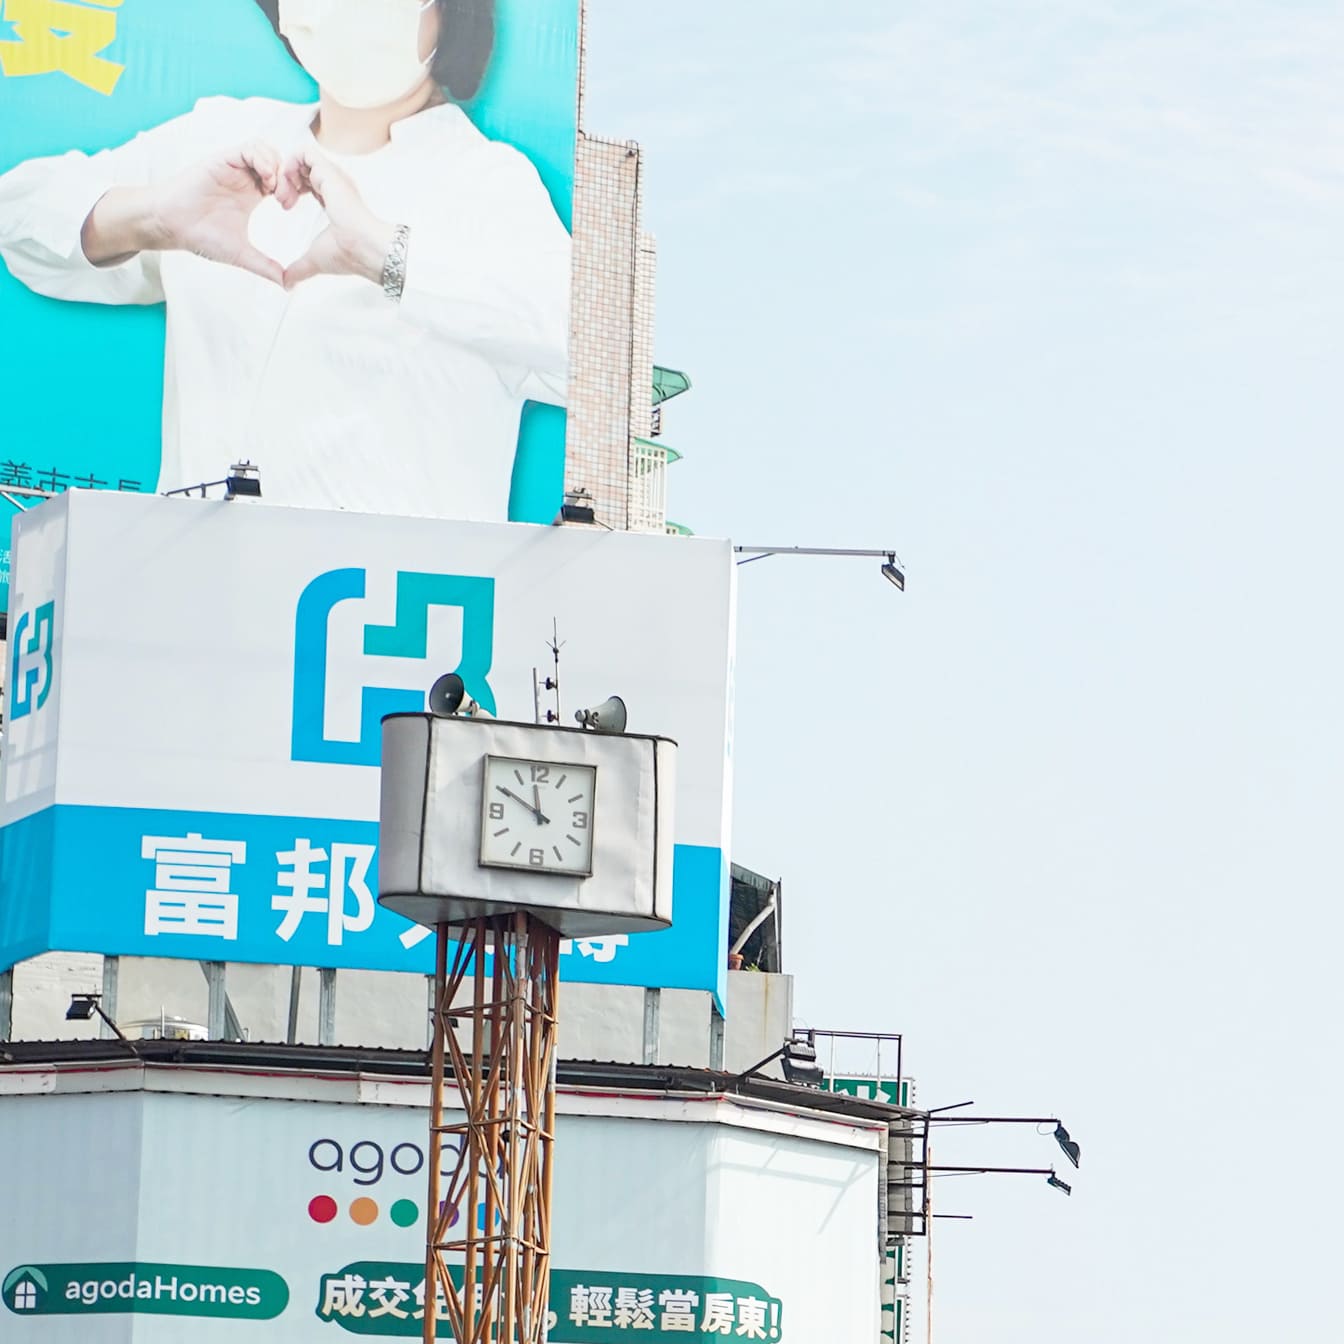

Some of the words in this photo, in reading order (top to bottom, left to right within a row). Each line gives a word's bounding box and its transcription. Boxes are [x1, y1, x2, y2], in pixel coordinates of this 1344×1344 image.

[530, 765, 549, 783] 12
[489, 802, 504, 819] 9
[572, 811, 587, 828] 3
[529, 848, 544, 865] 6
[65, 1273, 261, 1305] agodaHomes
